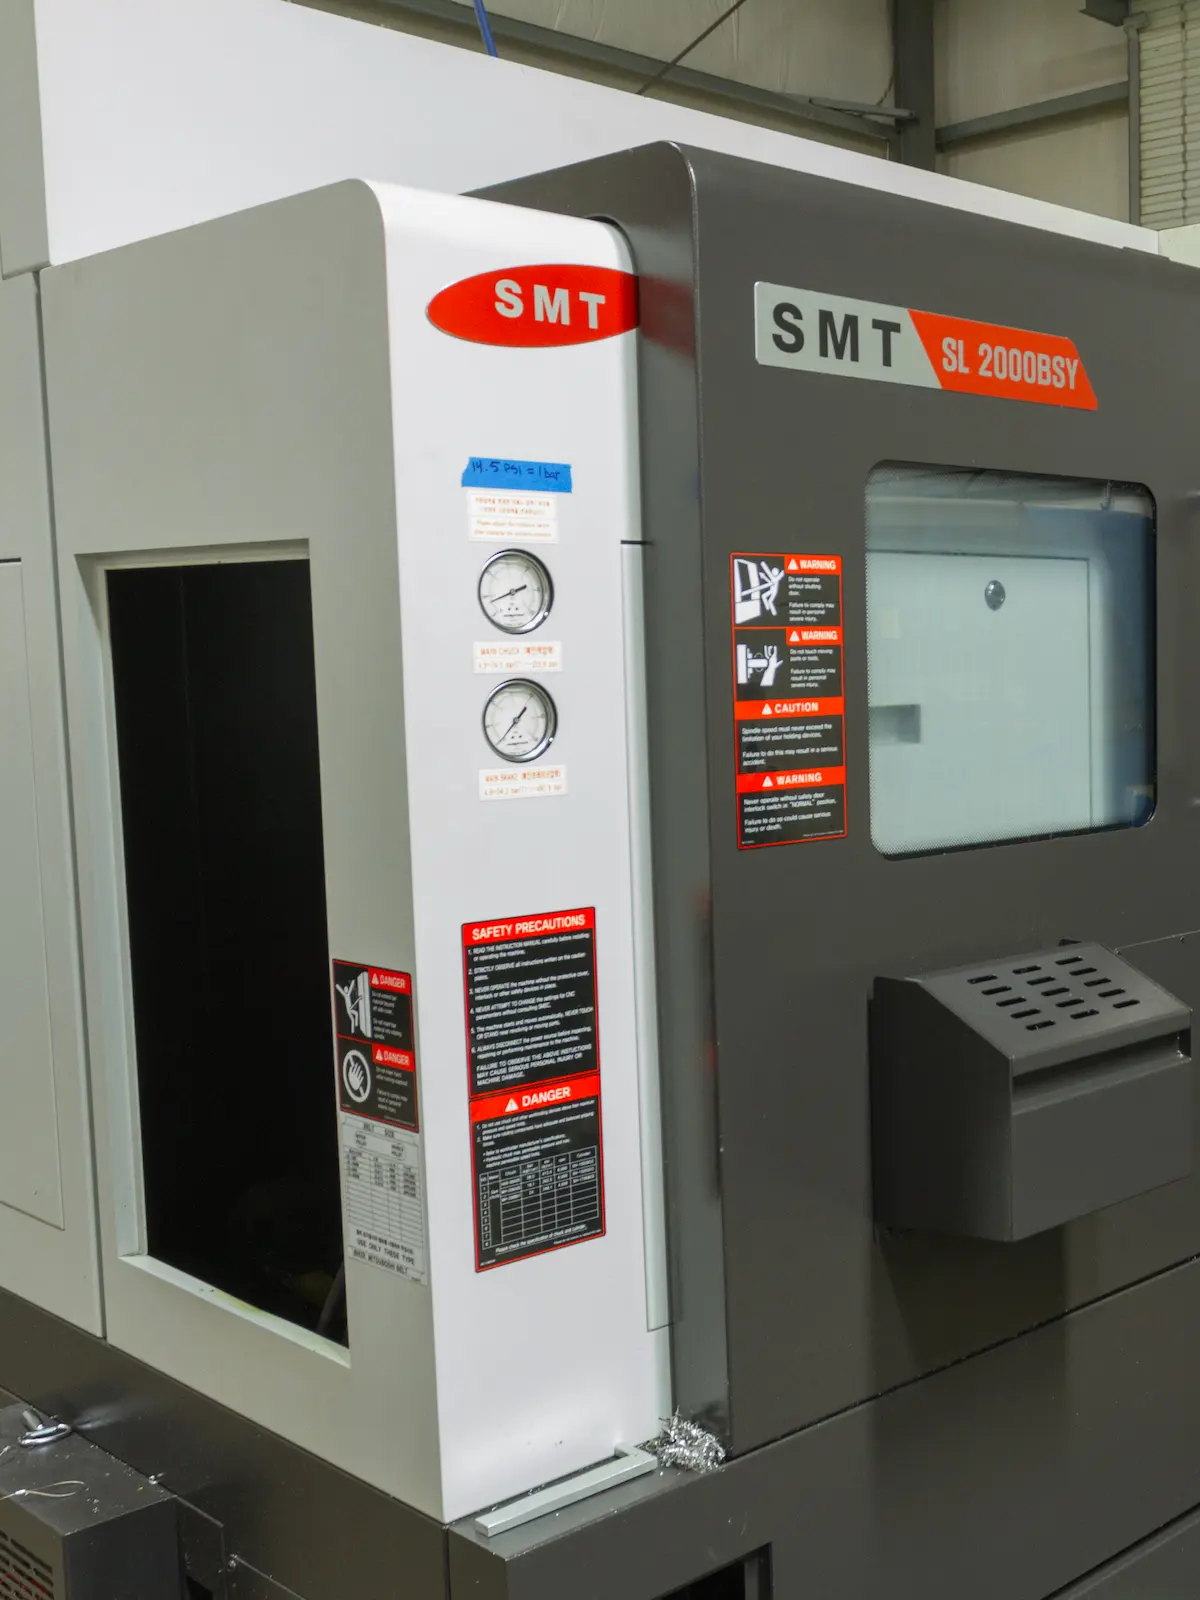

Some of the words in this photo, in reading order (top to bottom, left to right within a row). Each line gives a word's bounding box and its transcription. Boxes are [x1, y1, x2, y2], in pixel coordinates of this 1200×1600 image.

[494, 279, 606, 329] SMT
[771, 302, 901, 367] SMT
[941, 336, 969, 374] SL
[978, 343, 1080, 390] 2000BSY
[472, 460, 500, 473] 14.5
[543, 467, 560, 481] bar
[799, 559, 836, 569] WARNING
[801, 630, 837, 640] WARNING
[774, 702, 818, 713] CAUTION
[776, 772, 821, 785] WARNING
[472, 924, 512, 940] SAFETY
[515, 914, 584, 934] PRECAUTIONS
[379, 974, 405, 989] DANGER
[383, 1050, 409, 1066] DANGER
[476, 1062, 497, 1072] FAILURE
[507, 1056, 530, 1065] OBSERVE
[543, 1050, 558, 1058] ABOVE
[476, 1071, 488, 1079] MAY
[489, 1067, 506, 1076] CAUSE
[508, 1063, 529, 1072] SERIOUS
[530, 1057, 555, 1068] PERSONAL
[557, 1054, 573, 1062] INJURY
[477, 1076, 499, 1086] MACHINE
[522, 1086, 570, 1106] DANGER
